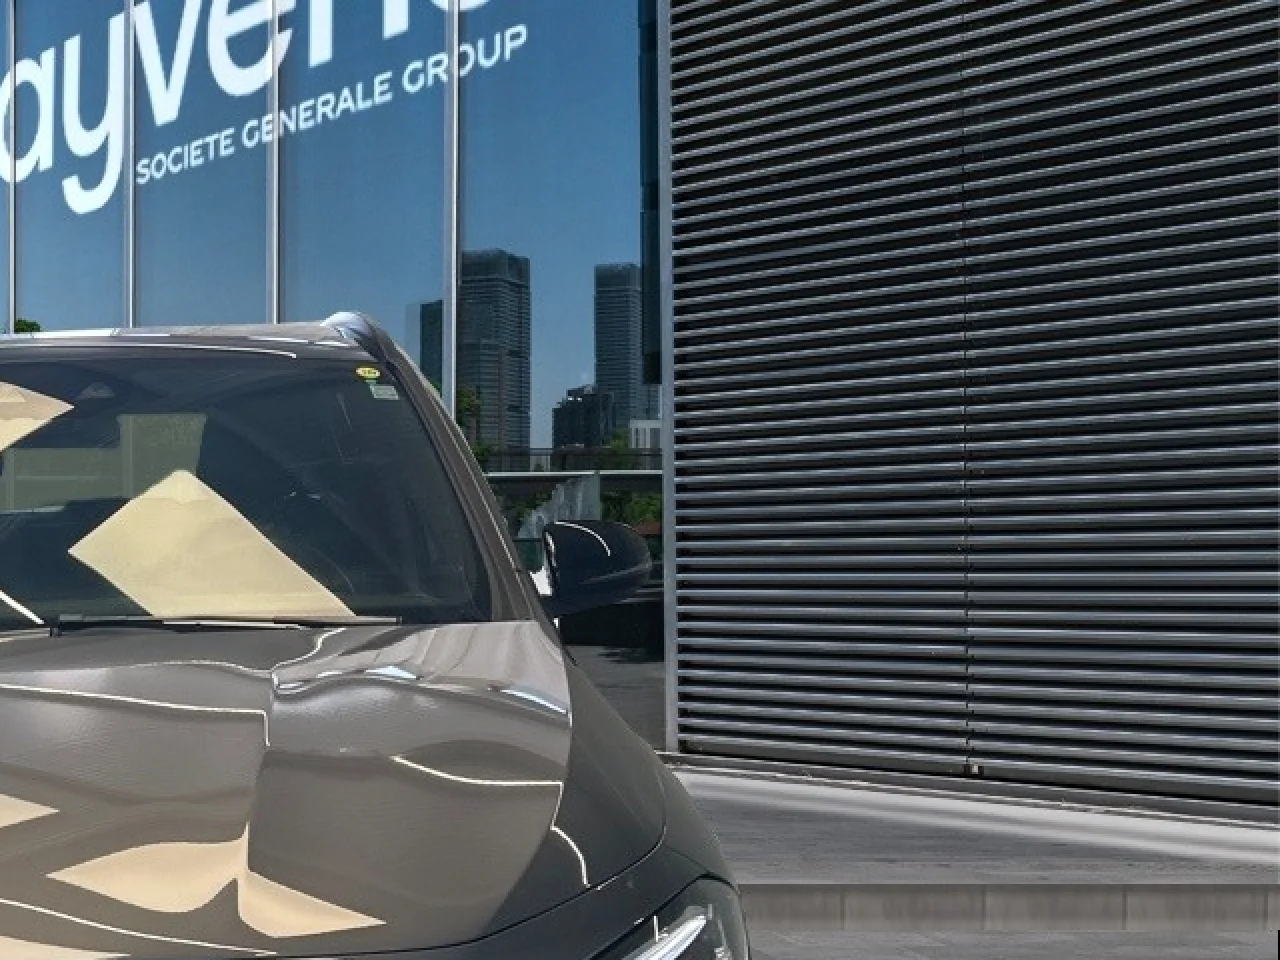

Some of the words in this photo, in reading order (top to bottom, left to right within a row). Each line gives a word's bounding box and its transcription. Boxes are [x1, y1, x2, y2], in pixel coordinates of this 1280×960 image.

[136, 128, 235, 185] SOCIETE
[242, 71, 393, 148] GENERALE
[402, 23, 527, 94] GROUP
